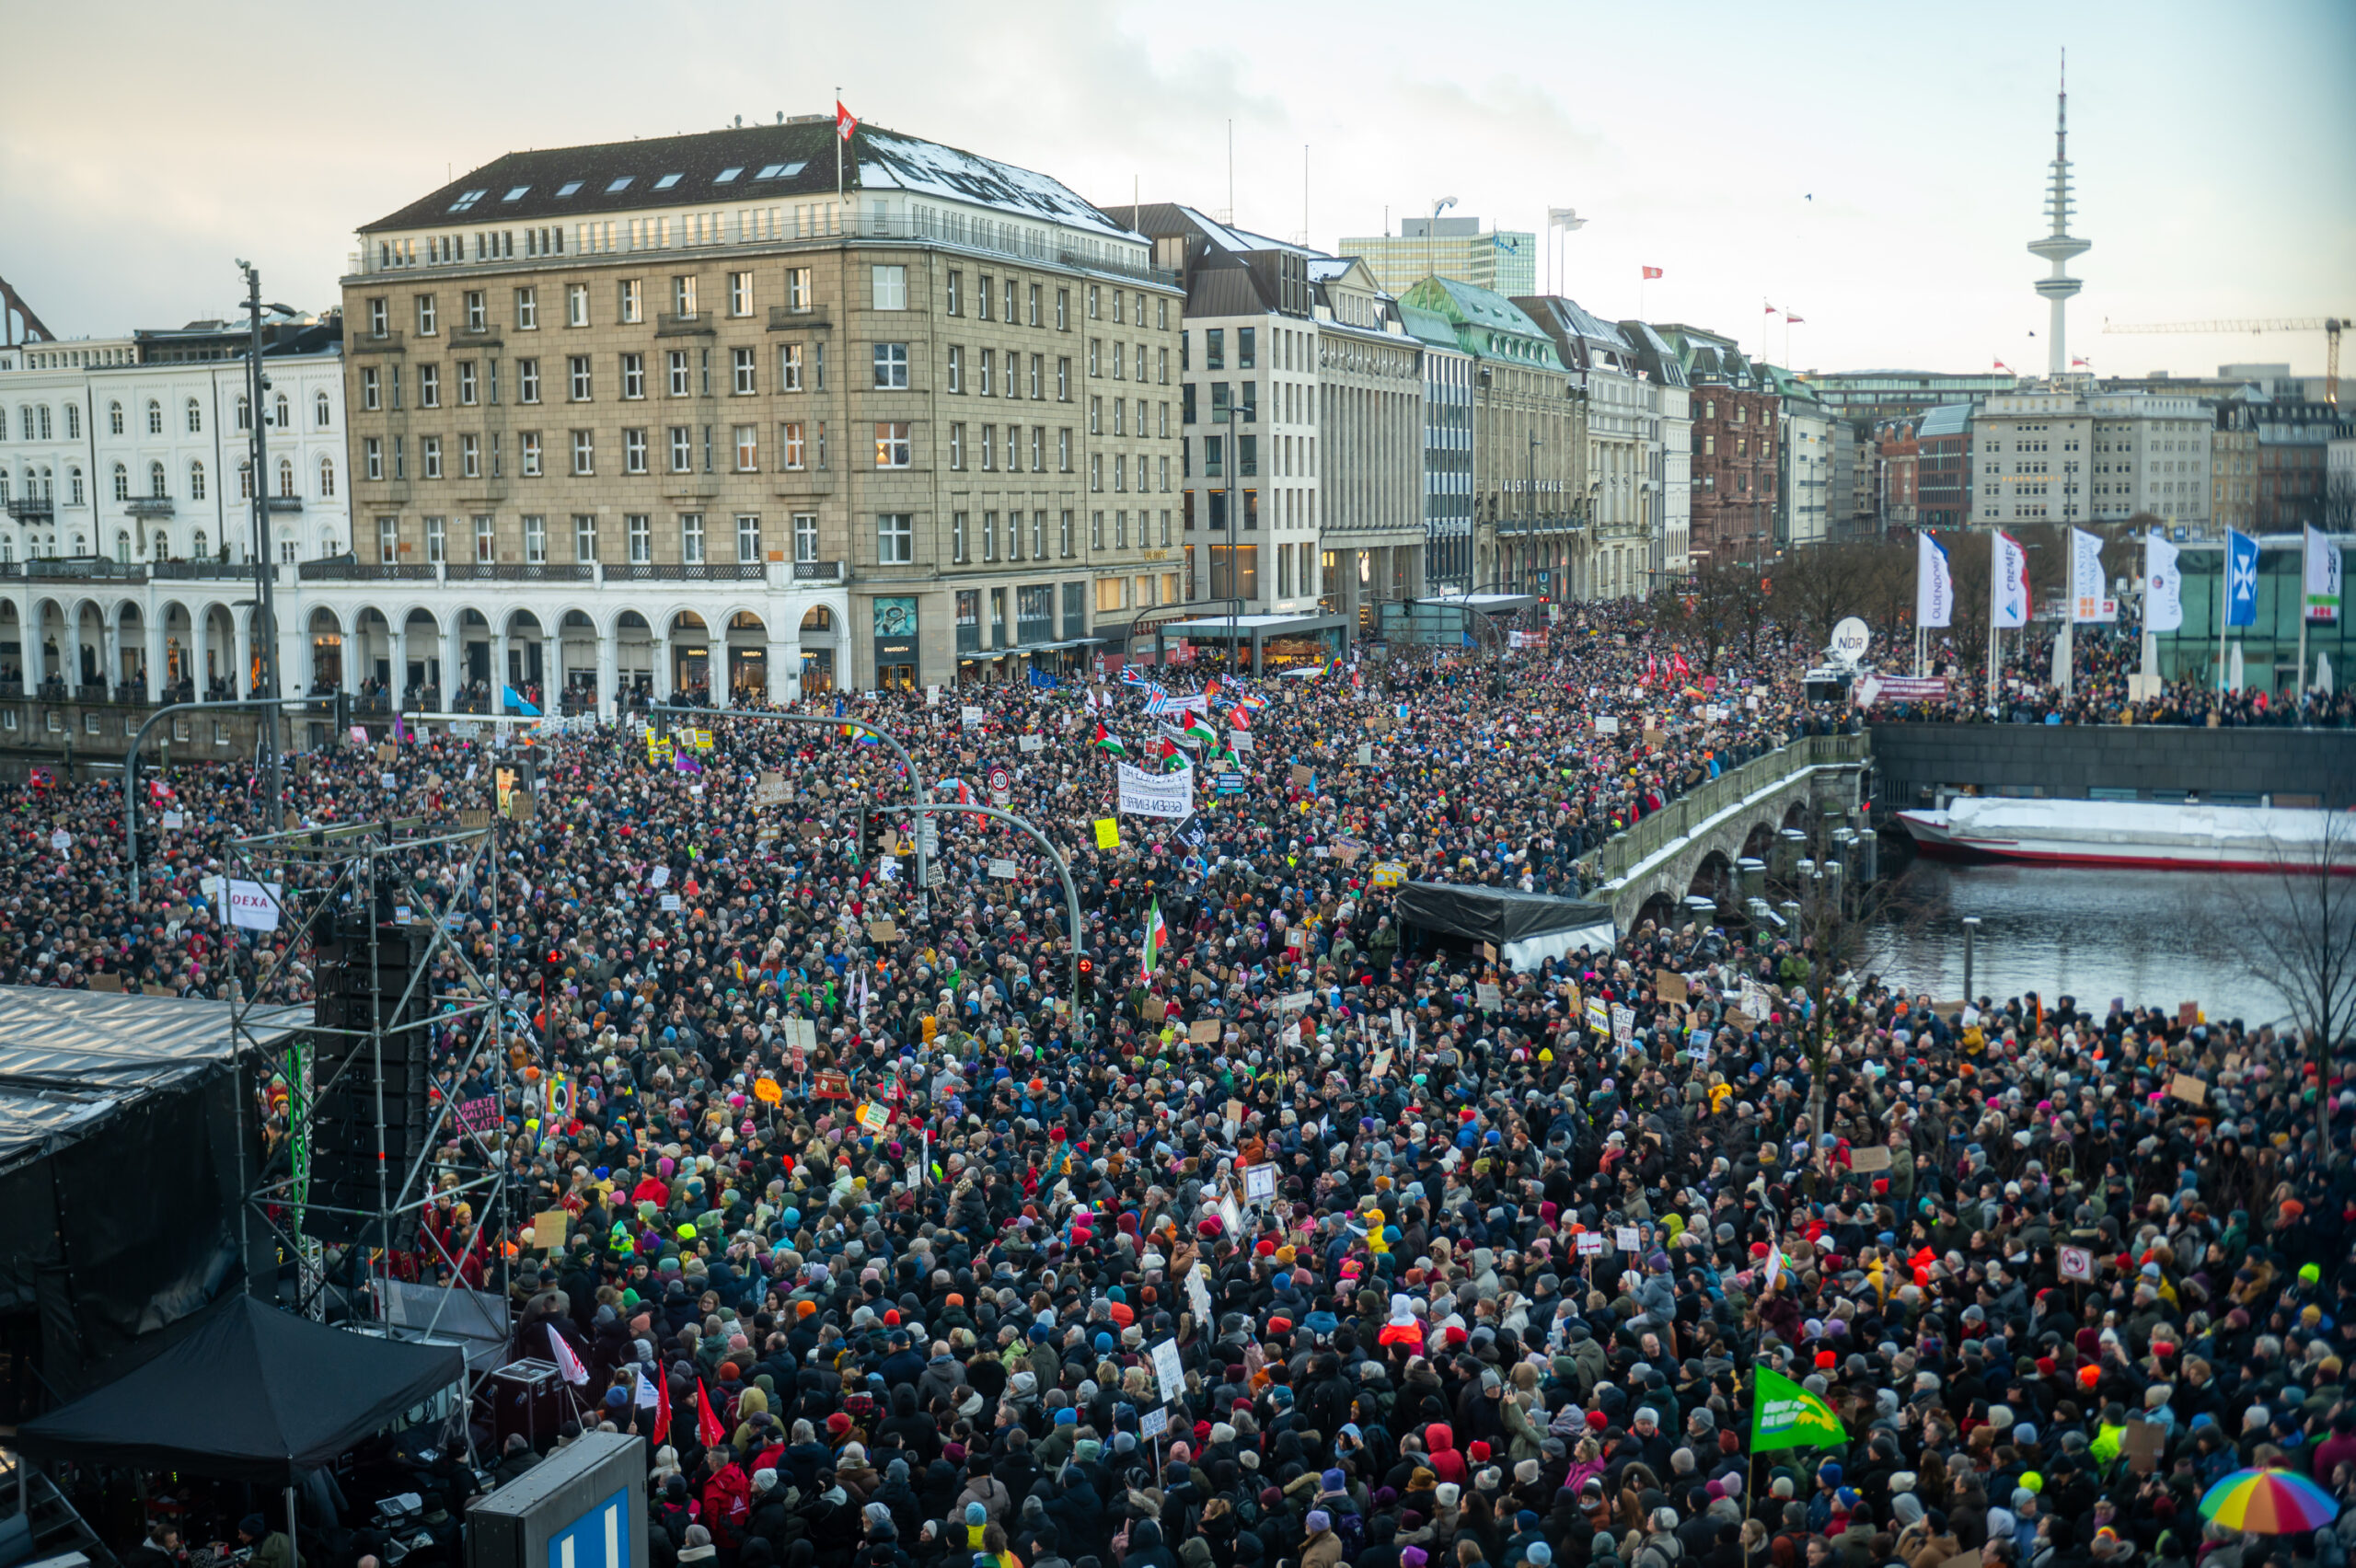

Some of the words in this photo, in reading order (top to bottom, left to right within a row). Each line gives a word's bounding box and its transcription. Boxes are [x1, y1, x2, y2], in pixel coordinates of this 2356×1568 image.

[1503, 479, 1564, 493] ALSTRHAUS
[1540, 572, 1548, 582] U
[1540, 585, 1548, 594] S
[1839, 637, 1863, 650] NDR
[994, 776, 1005, 786] 30
